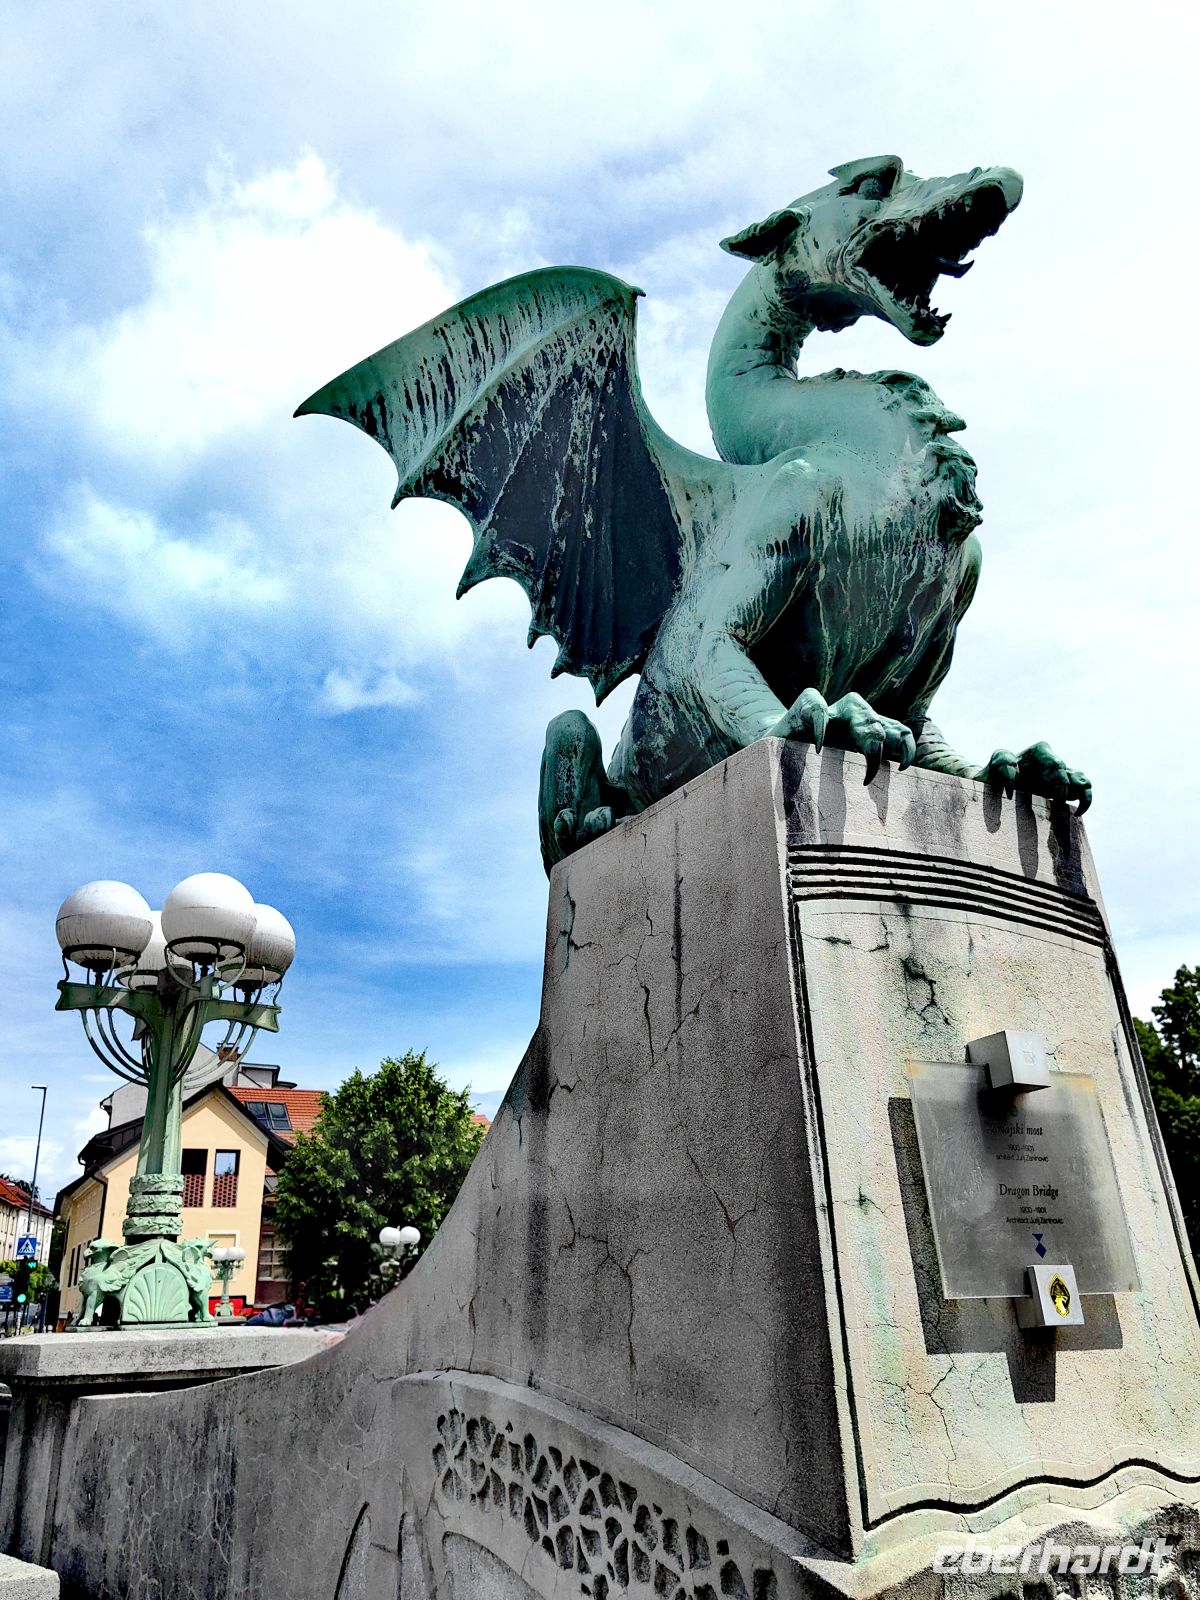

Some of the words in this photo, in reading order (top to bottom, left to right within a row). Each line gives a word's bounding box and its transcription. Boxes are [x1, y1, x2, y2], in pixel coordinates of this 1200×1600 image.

[1026, 1127, 1043, 1136] most
[999, 1183, 1030, 1199] Dragon
[1032, 1184, 1059, 1200] Bridge
